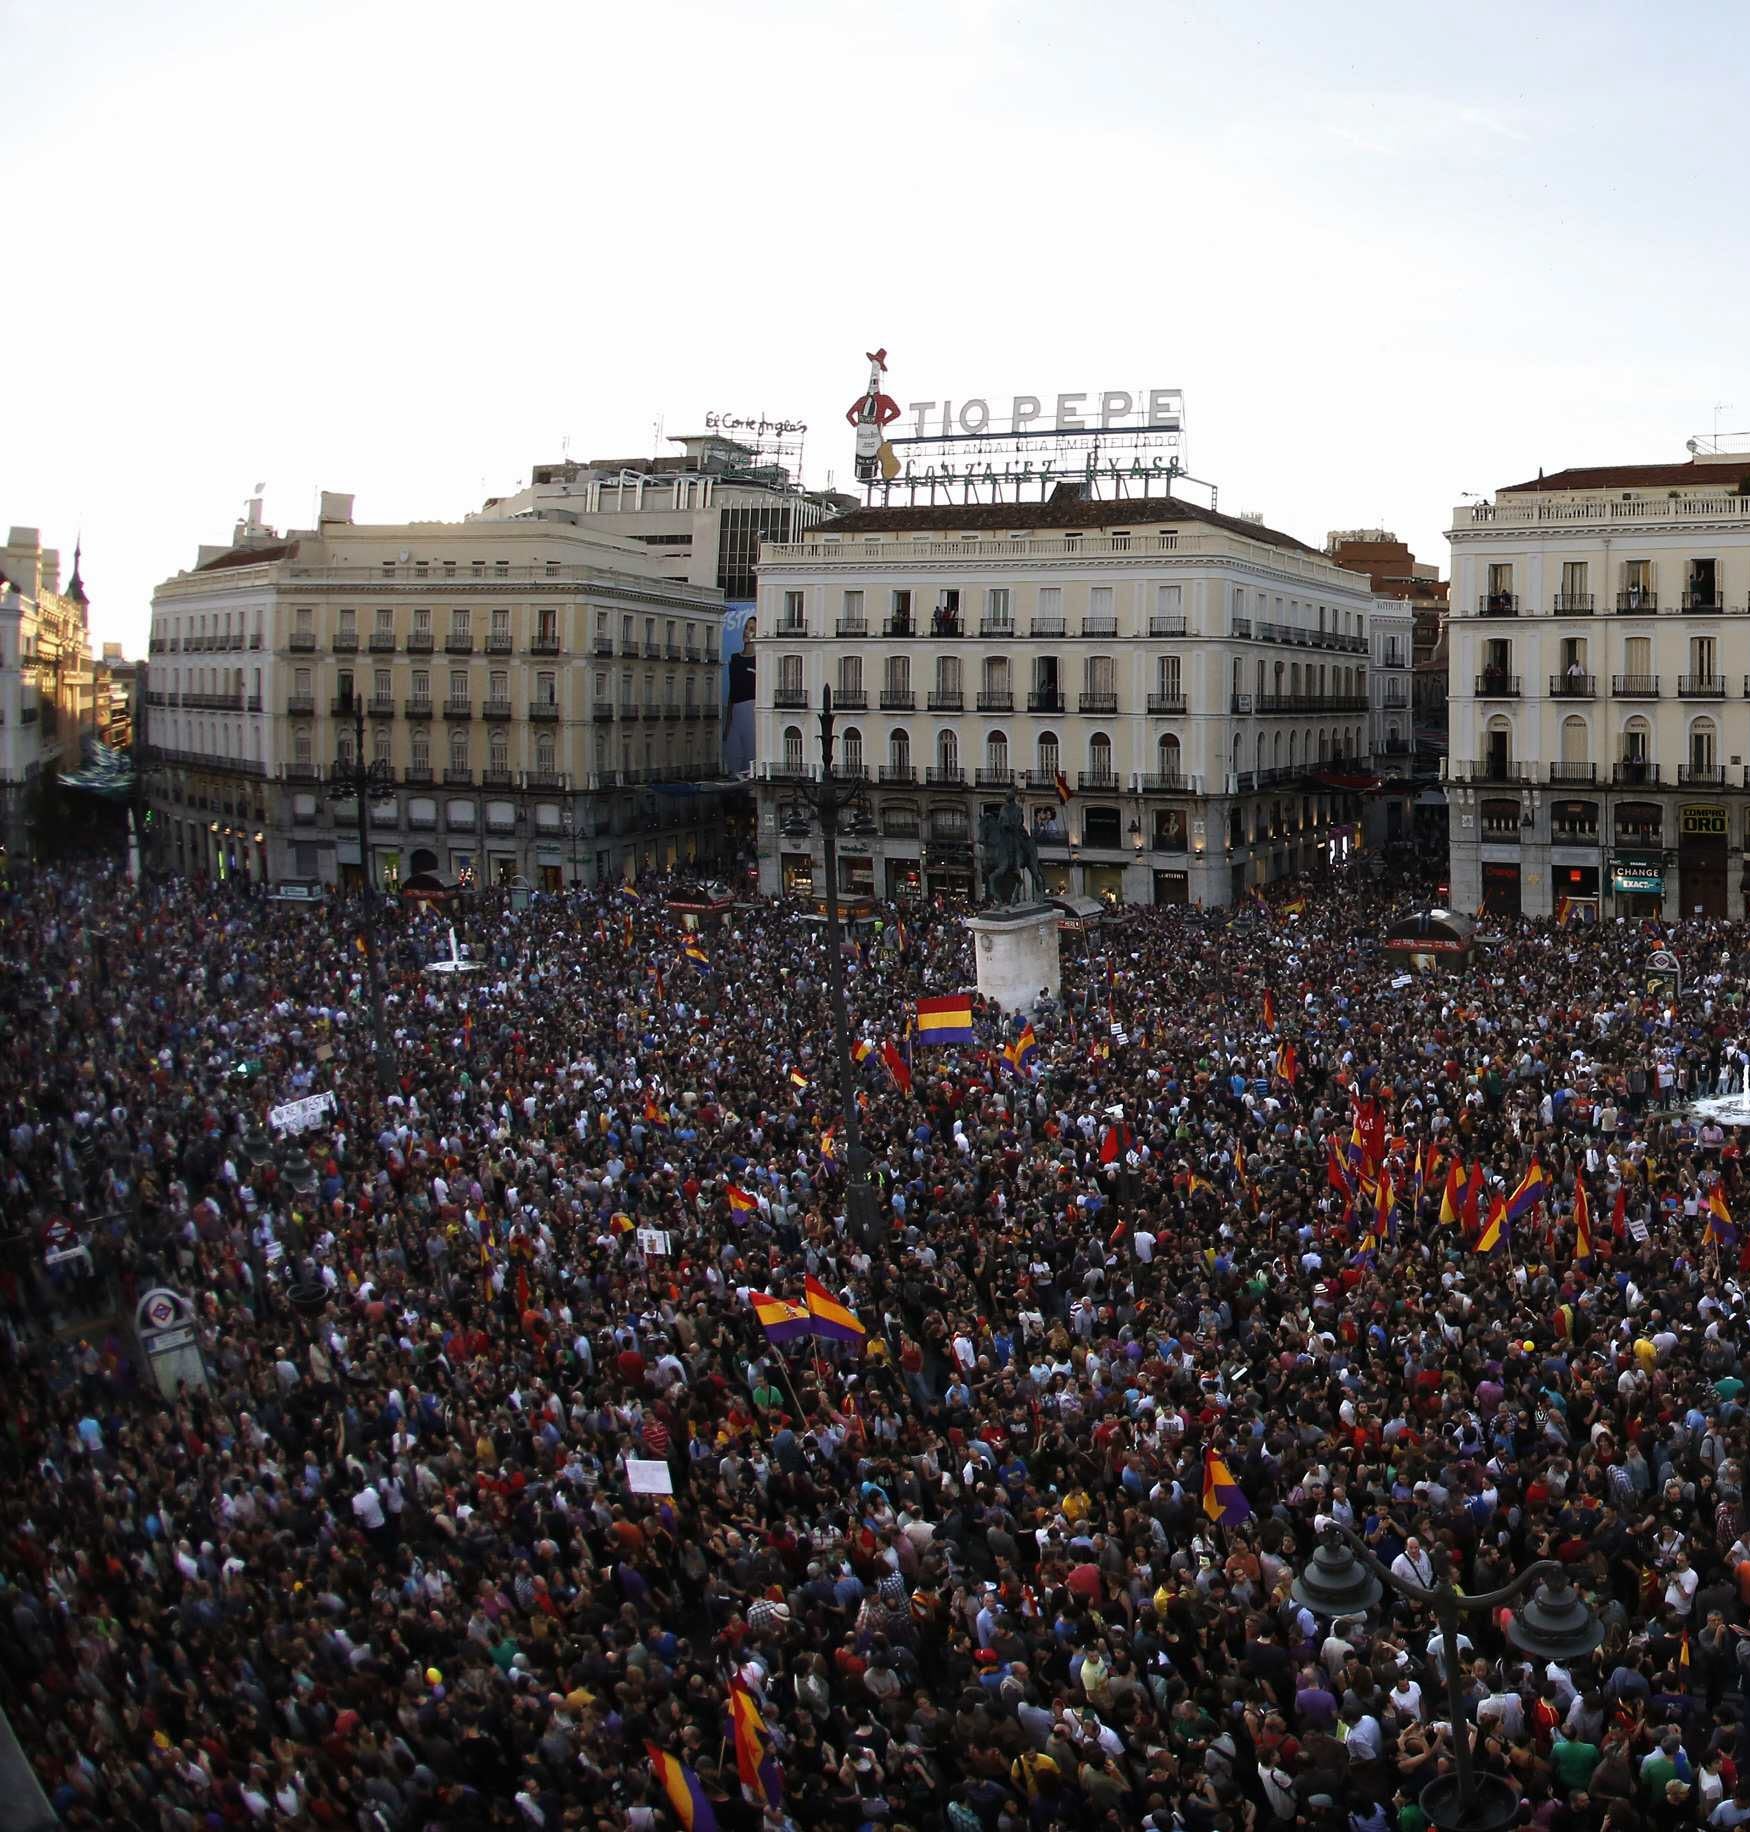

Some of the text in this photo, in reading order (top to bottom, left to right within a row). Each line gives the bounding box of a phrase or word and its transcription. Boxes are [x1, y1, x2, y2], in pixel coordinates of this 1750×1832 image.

[705, 411, 720, 428] El
[722, 413, 755, 430] Corte
[909, 389, 1182, 437] TIO PEPE
[1683, 809, 1726, 817] COMPRO
[1684, 817, 1725, 832] ORO
[1617, 868, 1659, 877] CHANGE
